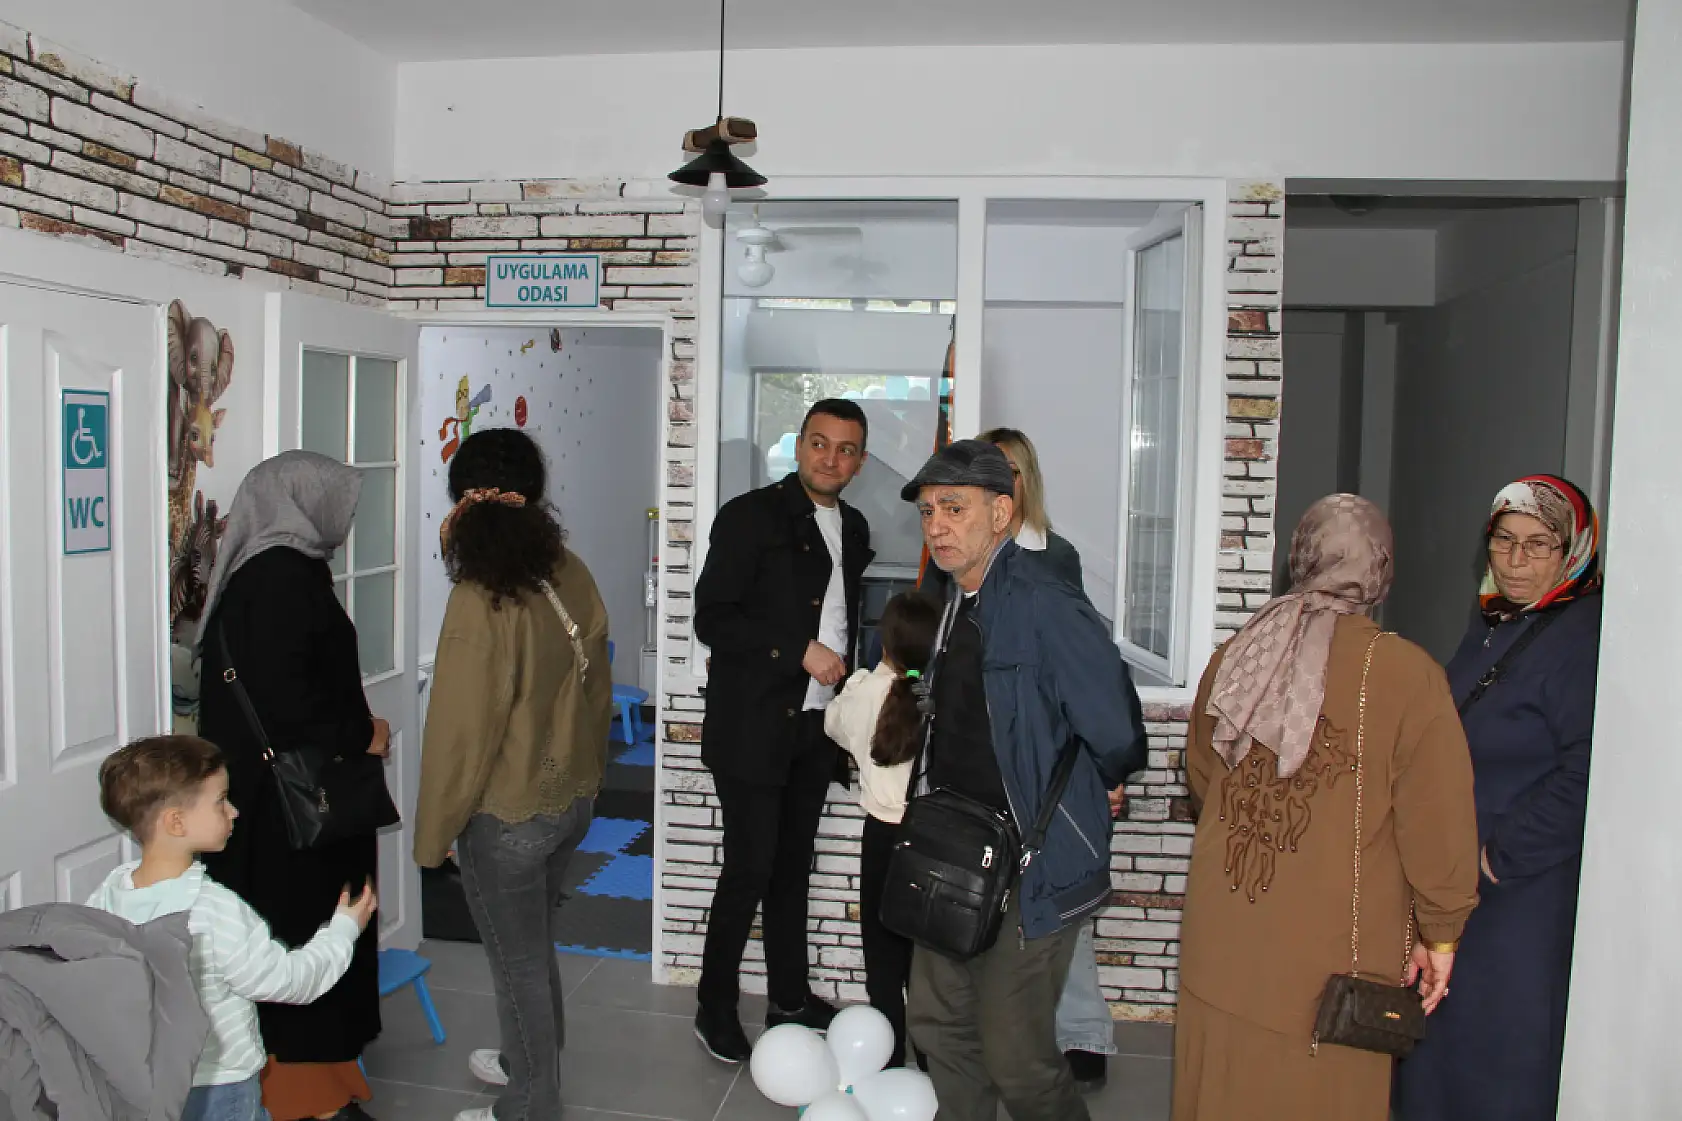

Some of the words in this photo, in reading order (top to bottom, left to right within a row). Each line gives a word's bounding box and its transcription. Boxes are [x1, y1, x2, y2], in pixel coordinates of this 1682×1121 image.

[497, 263, 589, 280] UYGULAMA
[517, 285, 568, 302] ODASI
[67, 496, 104, 529] WC
